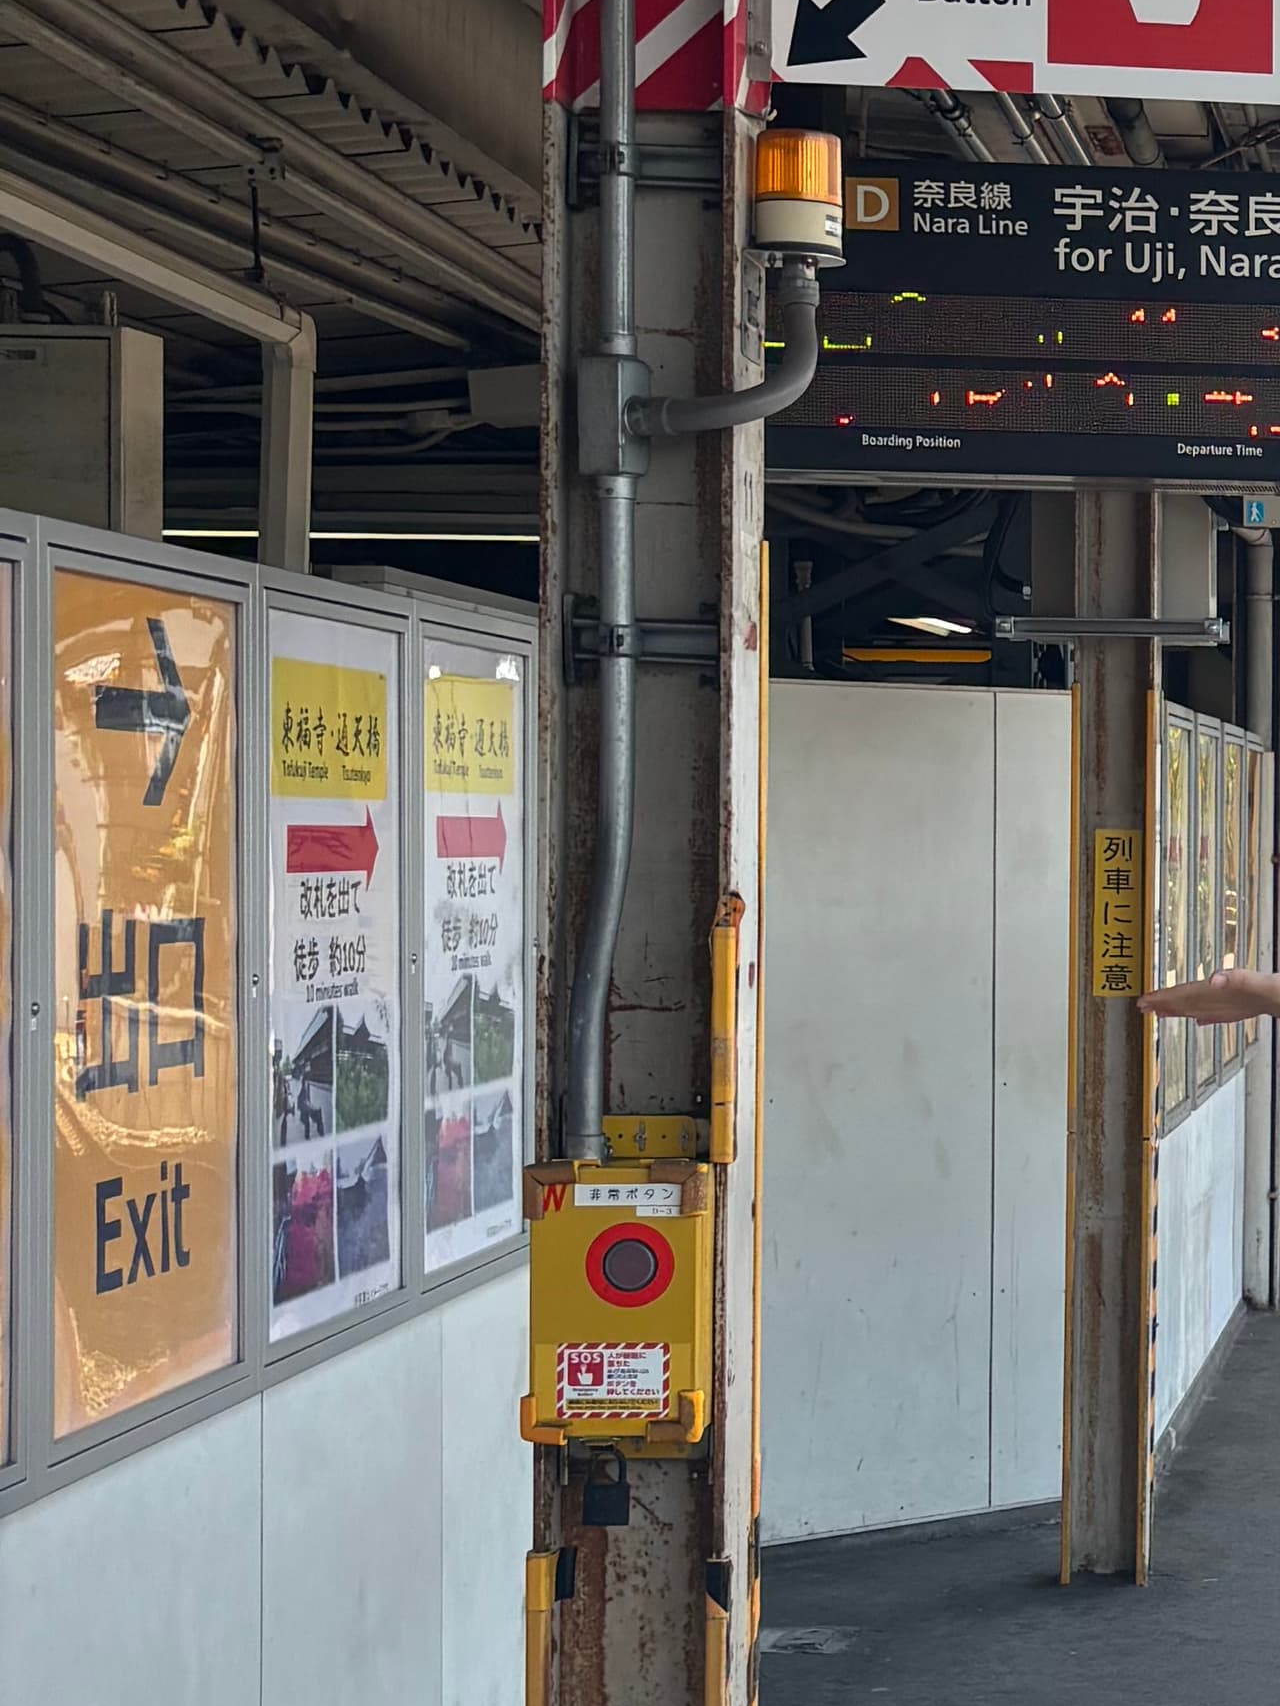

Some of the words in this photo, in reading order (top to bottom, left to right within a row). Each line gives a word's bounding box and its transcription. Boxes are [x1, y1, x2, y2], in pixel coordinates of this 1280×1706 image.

[855, 184, 890, 223] D
[913, 179, 1014, 212] 奈良線
[913, 213, 973, 236] Nara
[978, 215, 1029, 237] Line
[1055, 242, 1116, 274] for
[1124, 244, 1187, 283] Uji,
[861, 434, 909, 450] Boarding
[911, 435, 962, 450] Position
[1177, 443, 1234, 459] Departure
[1236, 444, 1263, 458] Time
[300, 878, 362, 920] 改札を出て
[1101, 835, 1135, 992] 列車に注意
[294, 938, 320, 983] 徒歩
[328, 934, 367, 978] 約10分
[76, 907, 208, 1103] 出口
[306, 983, 315, 1003] 10
[589, 1188, 675, 1202] 非常ボタン
[94, 1158, 193, 1297] Exit
[570, 1352, 602, 1364] SOS
